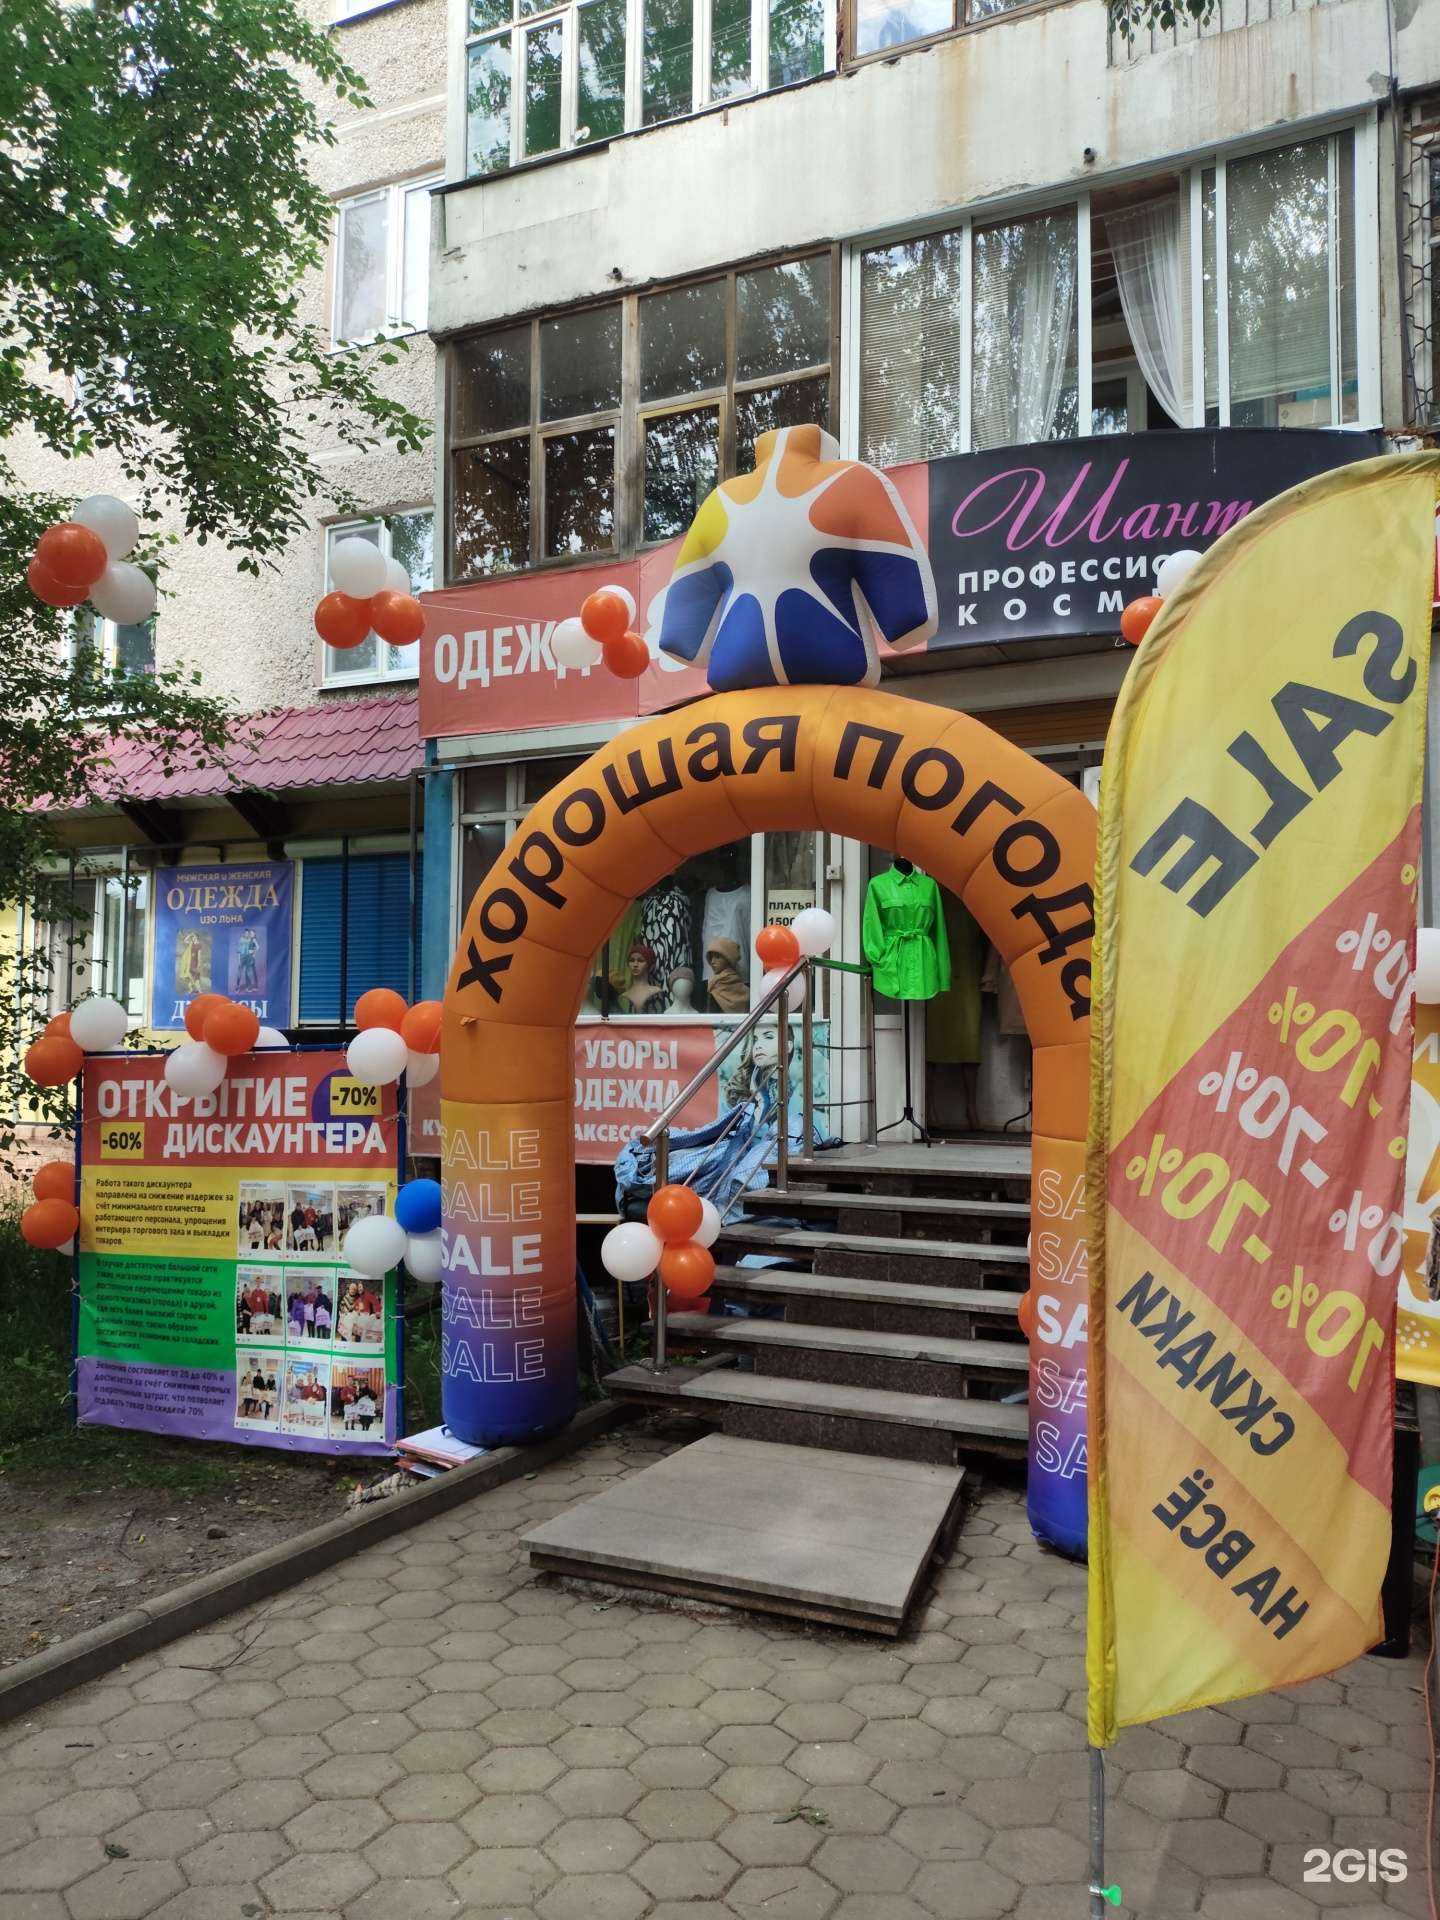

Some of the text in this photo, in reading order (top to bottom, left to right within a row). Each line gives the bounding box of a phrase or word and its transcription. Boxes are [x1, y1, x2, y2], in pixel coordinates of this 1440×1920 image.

[456, 715, 801, 1004] хорошая
[176, 872, 220, 883] МУЖСКАЯ
[228, 870, 273, 881] ЖЕНСКАЯ
[167, 884, 280, 914] ОДЕЖДА
[769, 902, 811, 911] ПЛАТЬЯ
[584, 1040, 678, 1070] УБОРЫ
[332, 1086, 377, 1106] -70%
[102, 1131, 142, 1151] -60%
[163, 1122, 387, 1159] ДИСКАУНТЕРА
[96, 1178, 121, 1187] Работа
[122, 1180, 145, 1188] такого
[164, 1204, 206, 1213] количества
